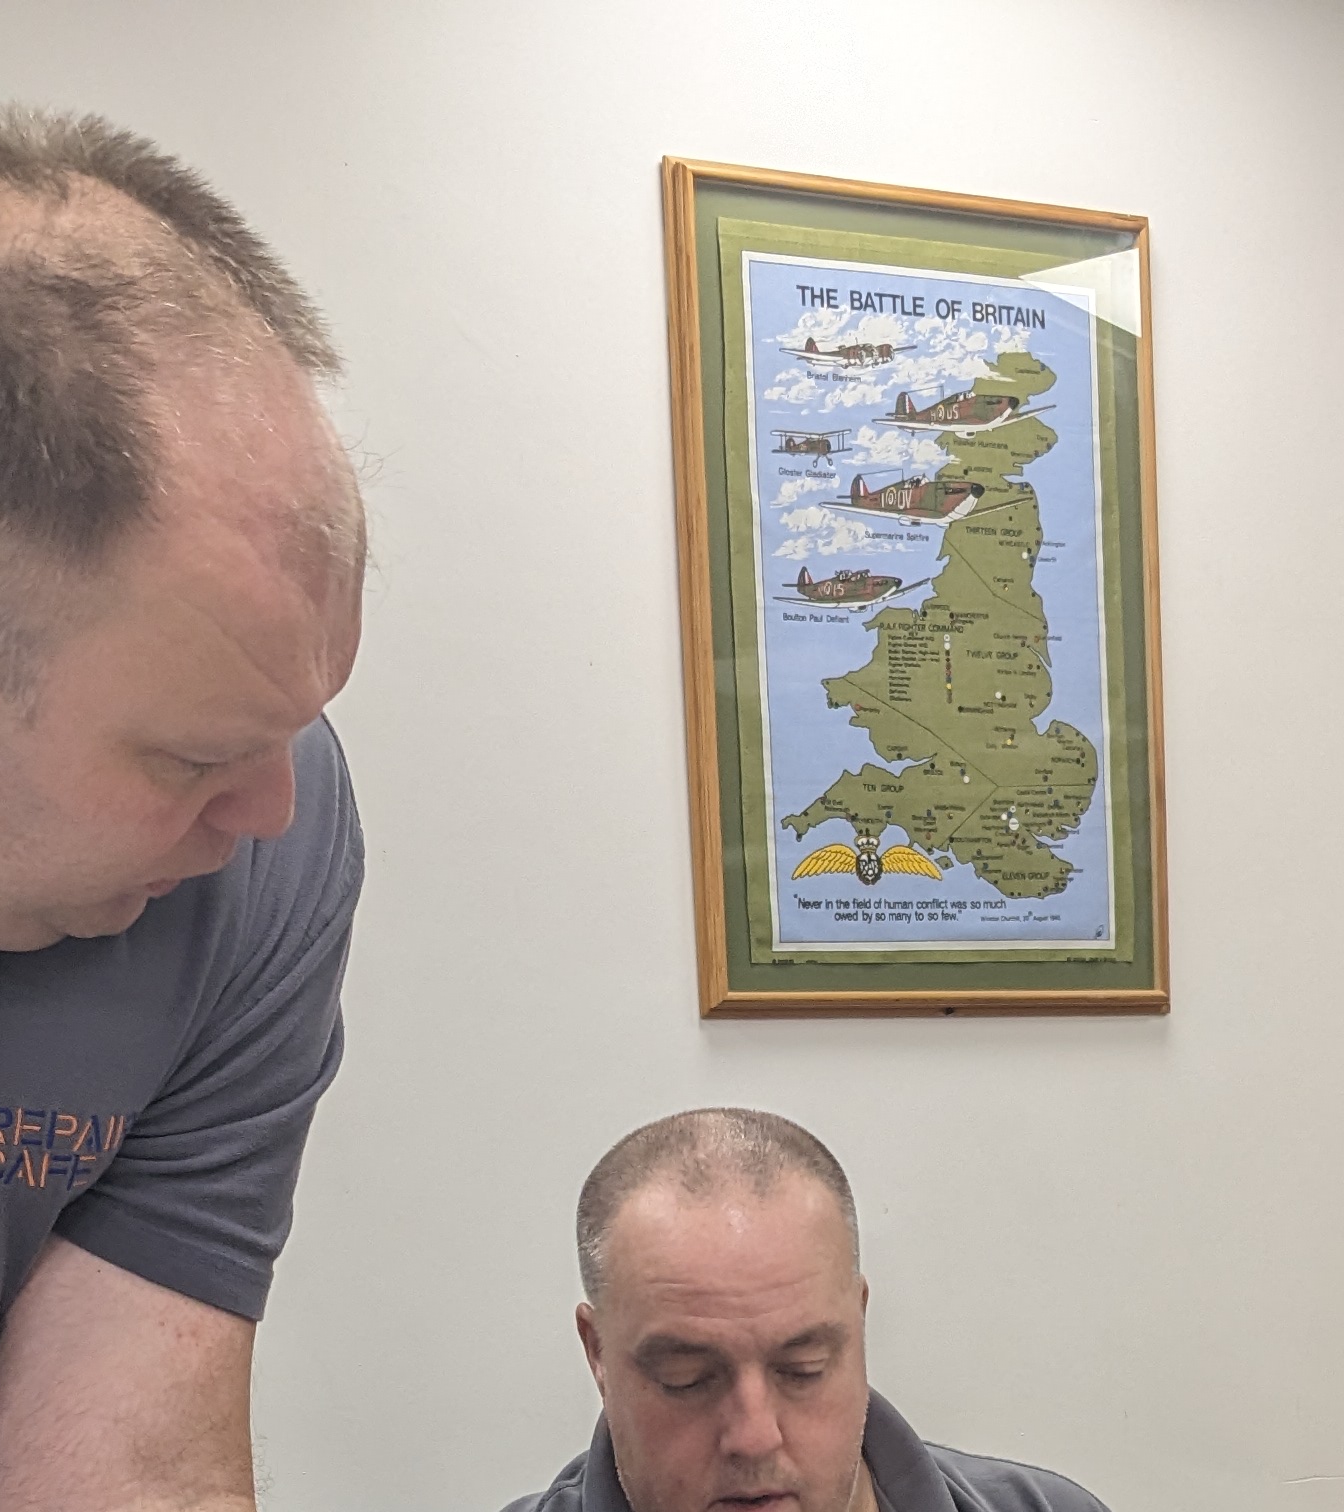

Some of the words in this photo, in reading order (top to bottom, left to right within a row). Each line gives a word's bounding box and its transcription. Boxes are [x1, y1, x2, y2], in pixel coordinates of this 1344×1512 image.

[796, 285, 839, 309] THE
[850, 290, 925, 317] BATTLE
[935, 298, 962, 320] OF
[972, 302, 1046, 329] BRITAIN
[779, 467, 803, 476] Gloster
[865, 531, 904, 542] Supermarine
[906, 532, 930, 542] Spitfire
[783, 613, 807, 622] Boulton
[809, 614, 823, 622] Paul
[826, 615, 850, 623] Defiant
[863, 783, 876, 792] TEN
[881, 784, 904, 793] GROUP
[825, 899, 833, 909] in
[836, 899, 850, 909] the
[853, 898, 871, 909] field
[873, 898, 882, 909] of
[884, 899, 913, 909] human
[916, 898, 949, 909] conflict
[950, 900, 967, 910] was
[970, 901, 981, 910] so
[983, 899, 1006, 909] much
[834, 911, 858, 921] owed
[862, 910, 873, 924] by
[875, 912, 886, 921] so
[888, 912, 911, 924] many
[915, 911, 925, 921] to
[927, 912, 939, 921] so
